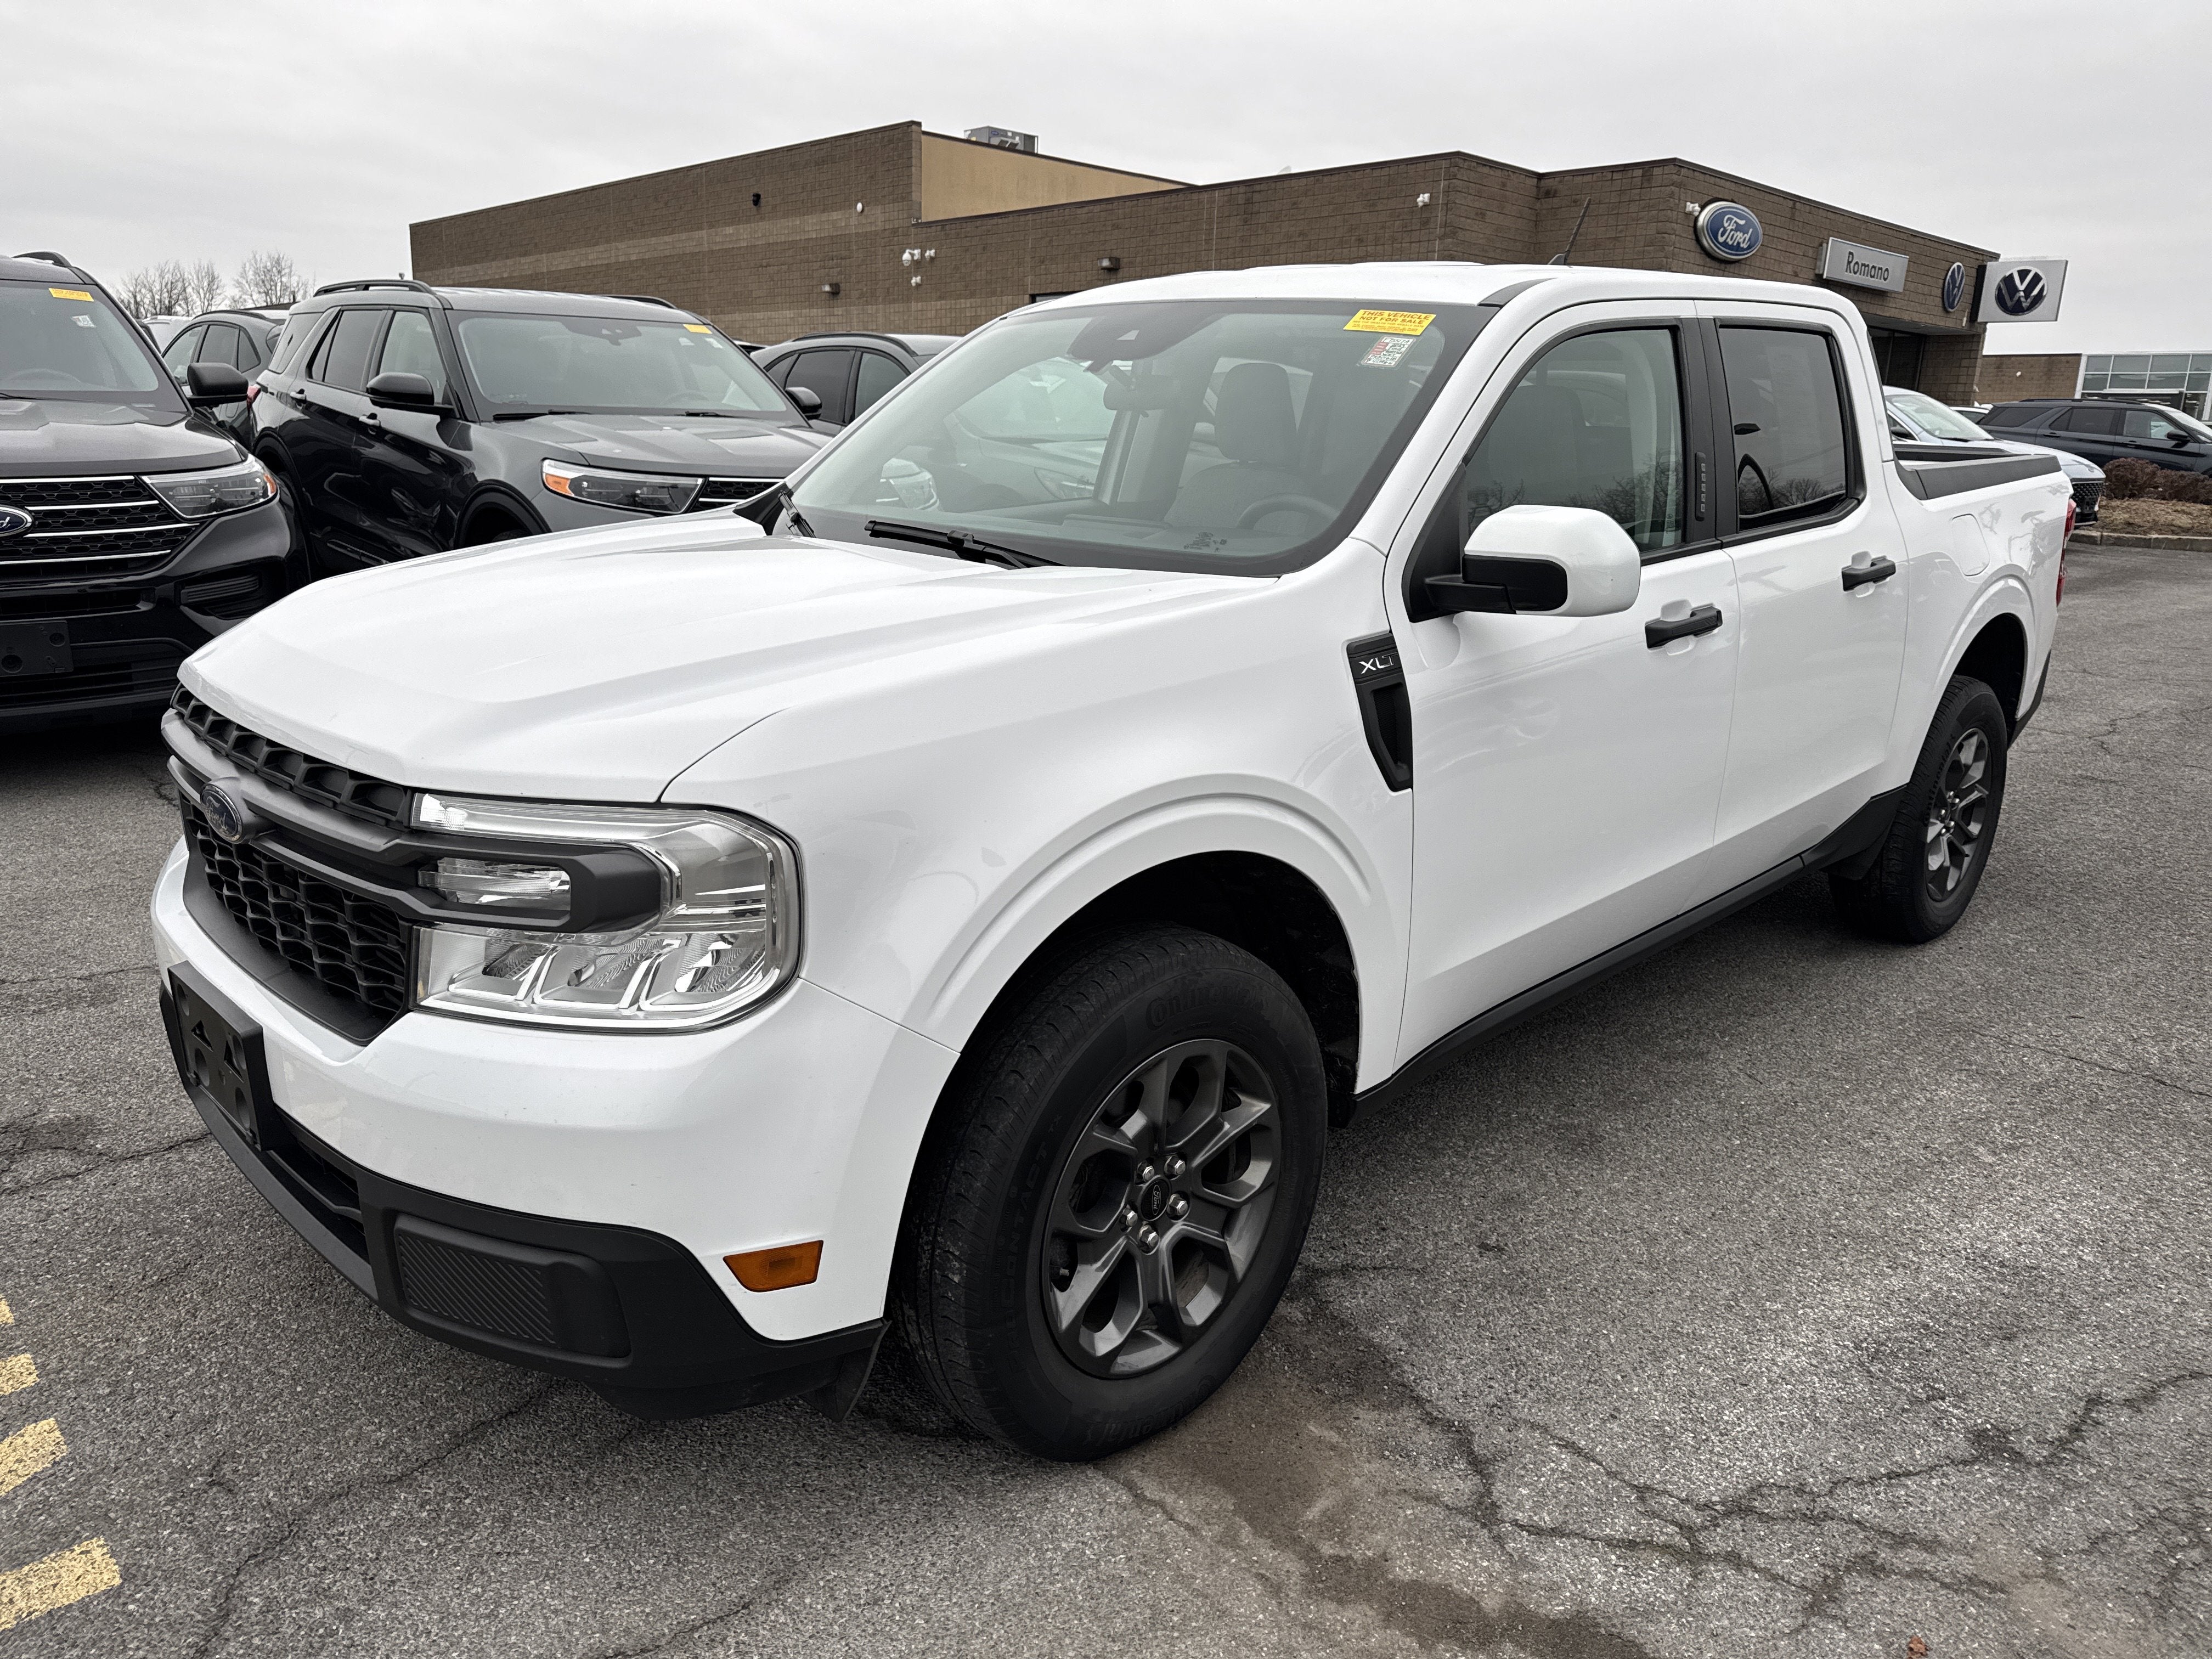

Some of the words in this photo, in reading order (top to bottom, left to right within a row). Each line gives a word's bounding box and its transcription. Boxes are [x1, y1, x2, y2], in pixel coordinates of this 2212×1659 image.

[1718, 215, 1753, 249] Ford
[1846, 251, 1889, 281] Romano
[1387, 312, 1431, 320] VEHICLE
[1359, 652, 1397, 674] XLT
[206, 796, 228, 831] Ford
[1146, 985, 1260, 1031] Continental
